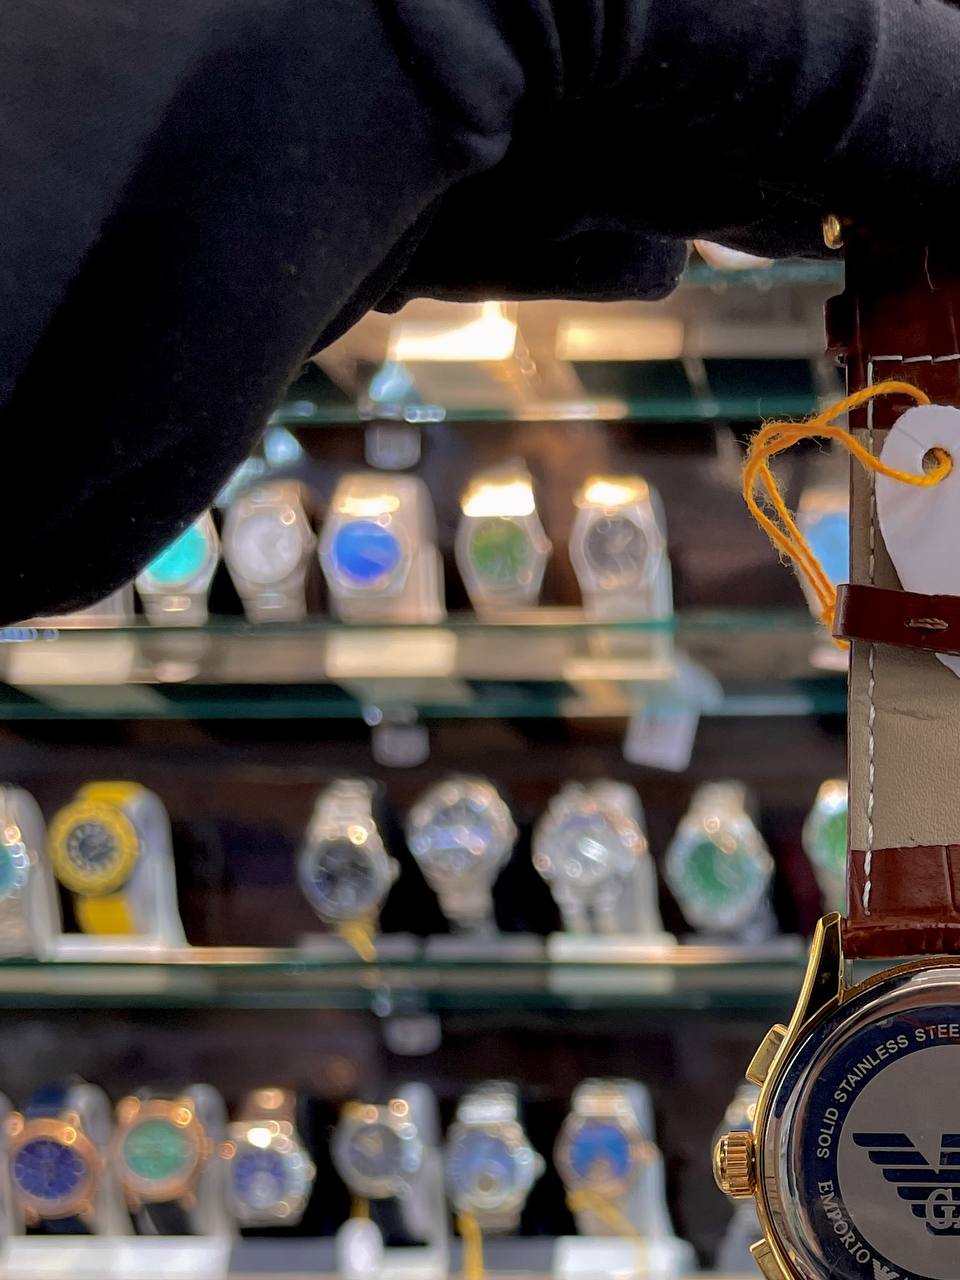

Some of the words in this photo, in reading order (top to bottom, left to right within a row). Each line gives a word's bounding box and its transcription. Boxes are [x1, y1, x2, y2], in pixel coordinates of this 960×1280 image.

[816, 1107, 839, 1159] SOLID
[834, 1034, 909, 1103] STAINLESS
[817, 1180, 871, 1264] EMPORIO
